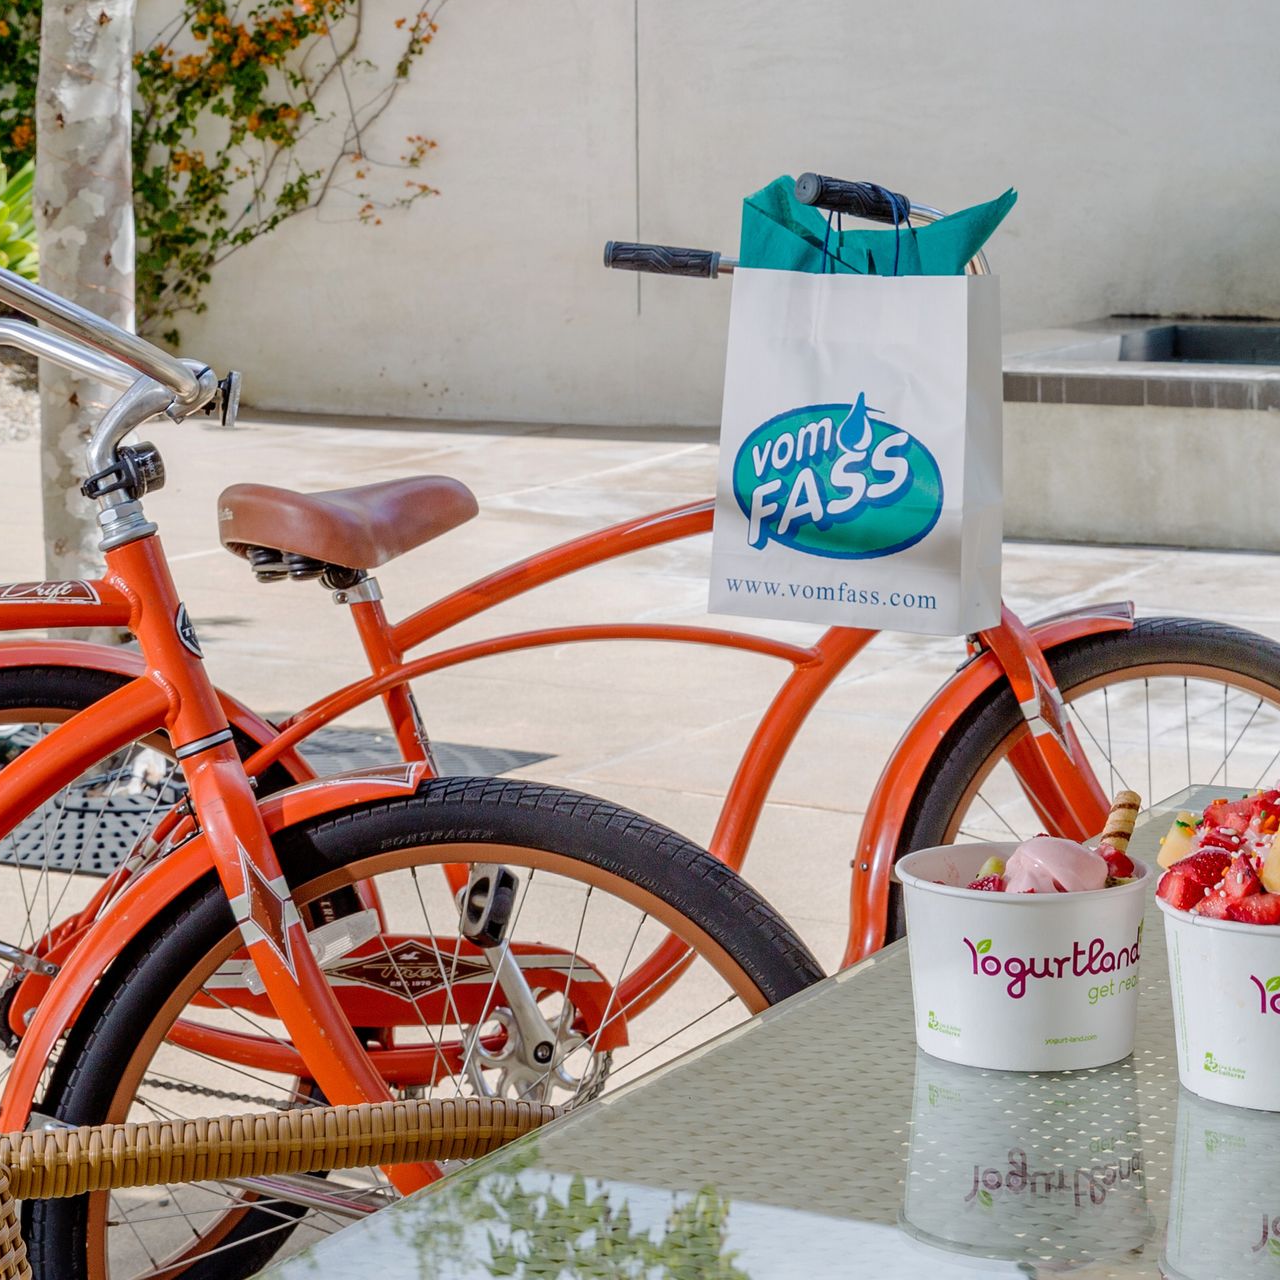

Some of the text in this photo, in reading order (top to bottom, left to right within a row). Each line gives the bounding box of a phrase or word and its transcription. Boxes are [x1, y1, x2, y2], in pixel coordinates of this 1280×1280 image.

[751, 417, 833, 477] vom
[747, 431, 910, 547] FASS
[725, 577, 938, 610] www.vomfass.com
[963, 925, 1141, 999] Yogurtland
[1088, 978, 1115, 1005] get
